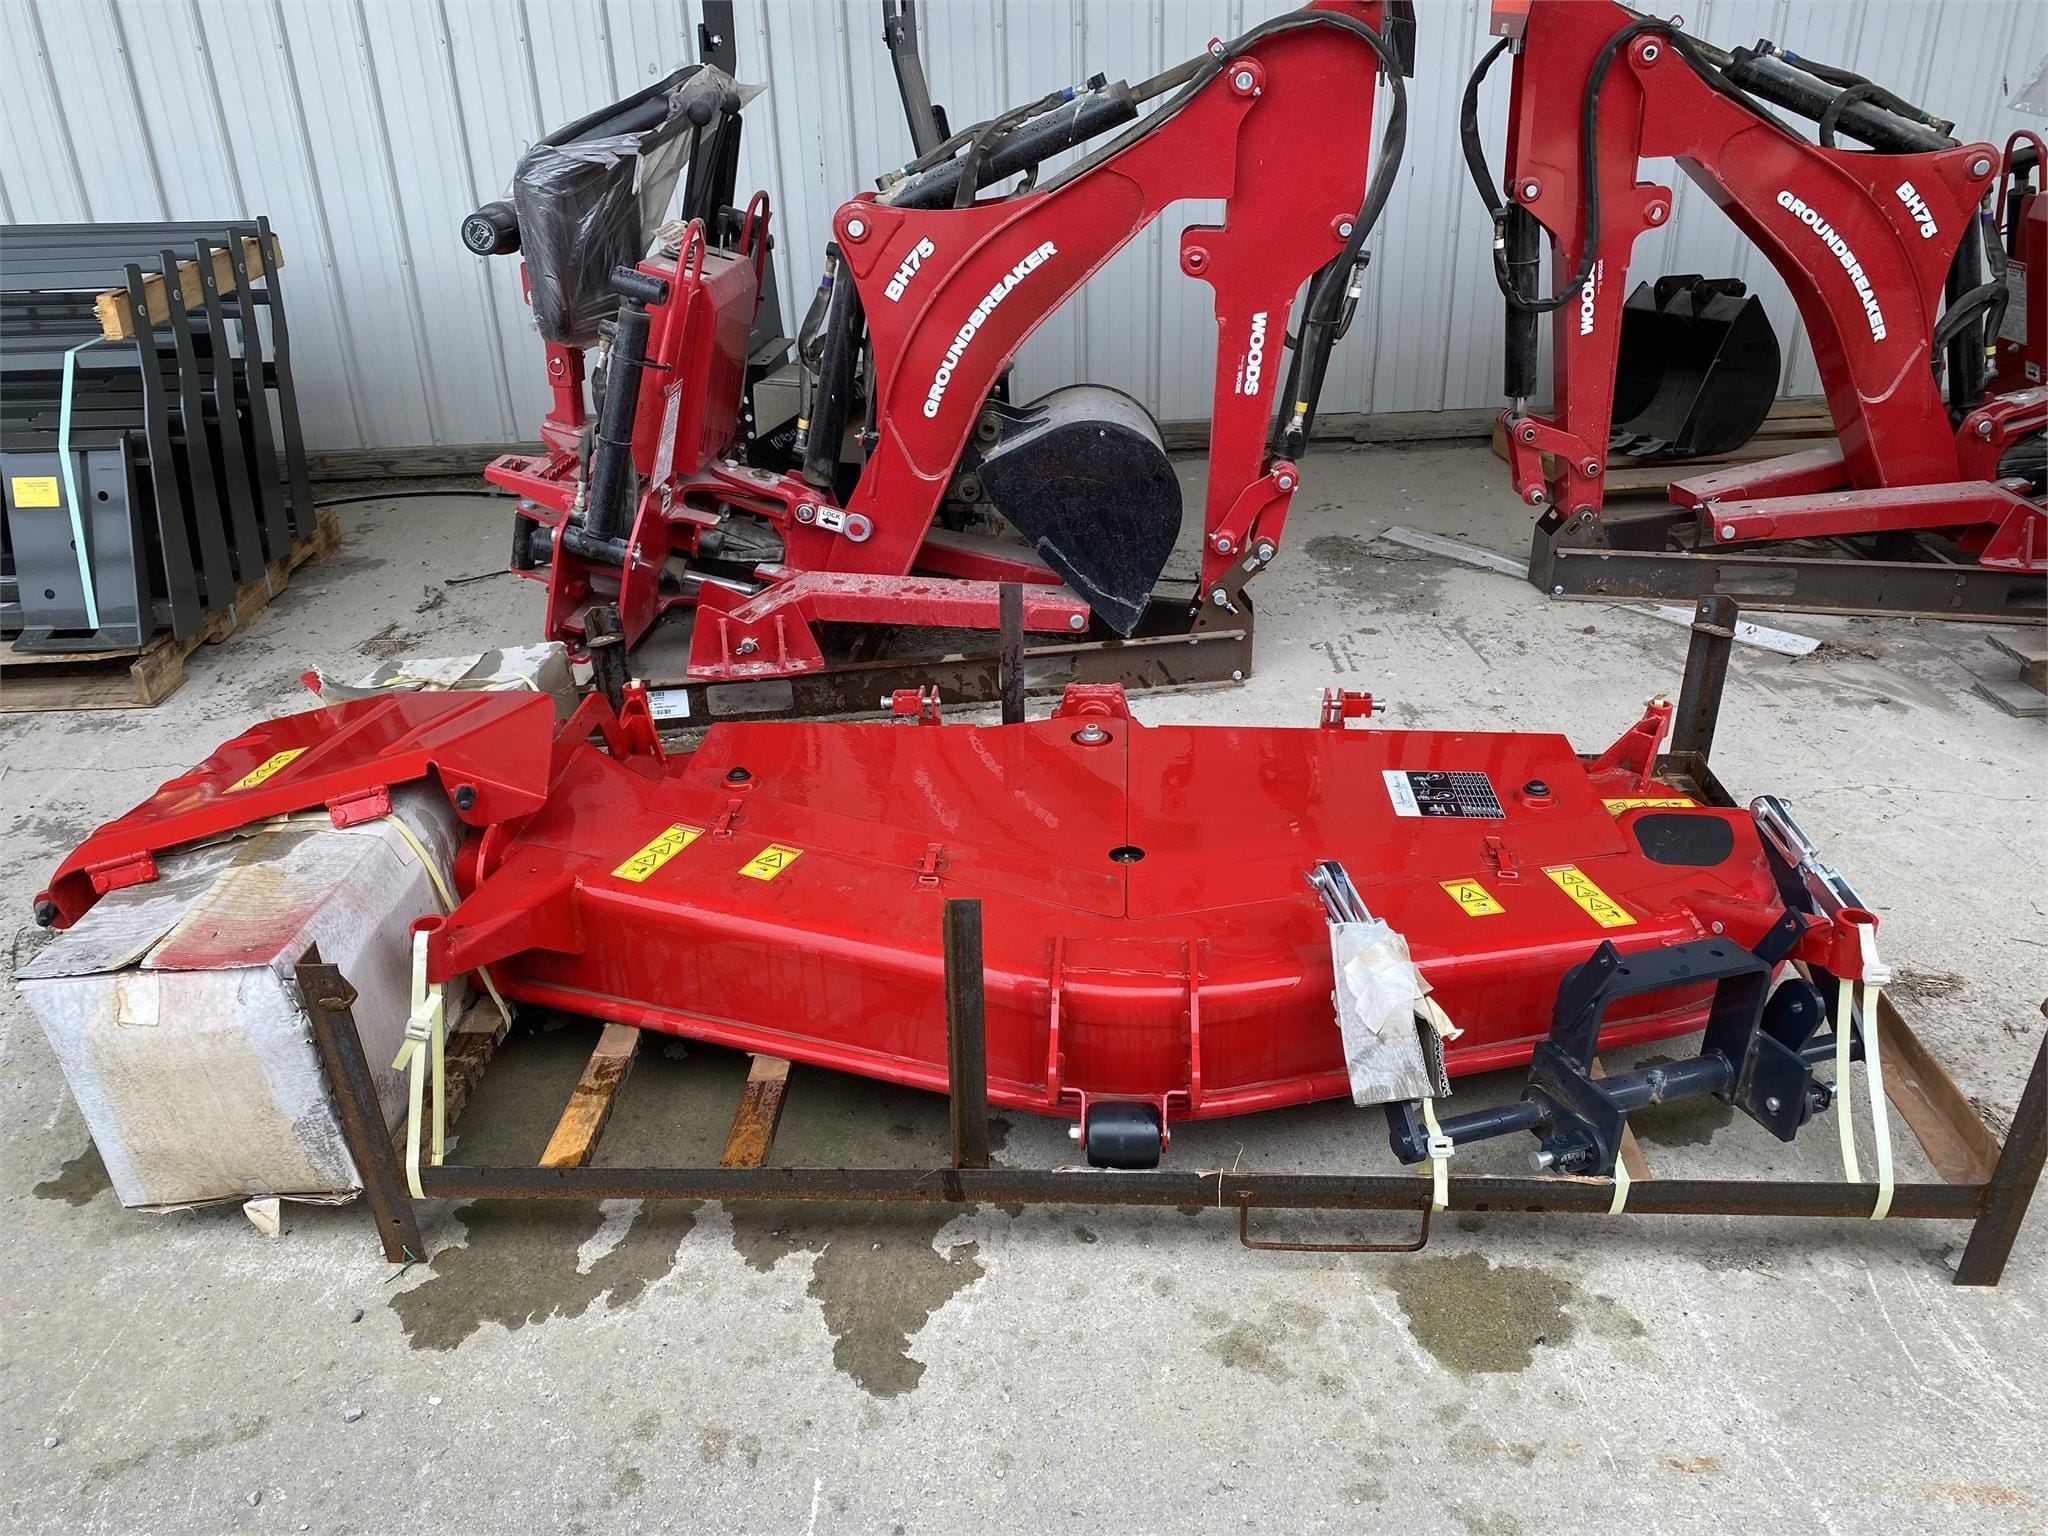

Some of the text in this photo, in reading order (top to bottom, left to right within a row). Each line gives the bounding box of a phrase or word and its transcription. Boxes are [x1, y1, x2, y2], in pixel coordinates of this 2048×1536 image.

[1895, 180, 1938, 239] BH75
[884, 235, 936, 303] BH75
[1580, 261, 1596, 336] WOOD
[1776, 190, 1887, 343] GROUNDBREAKER
[923, 240, 1059, 419] GROUNDBREAKER
[1243, 311, 1268, 396] WOODS
[822, 509, 841, 520] LOCK
